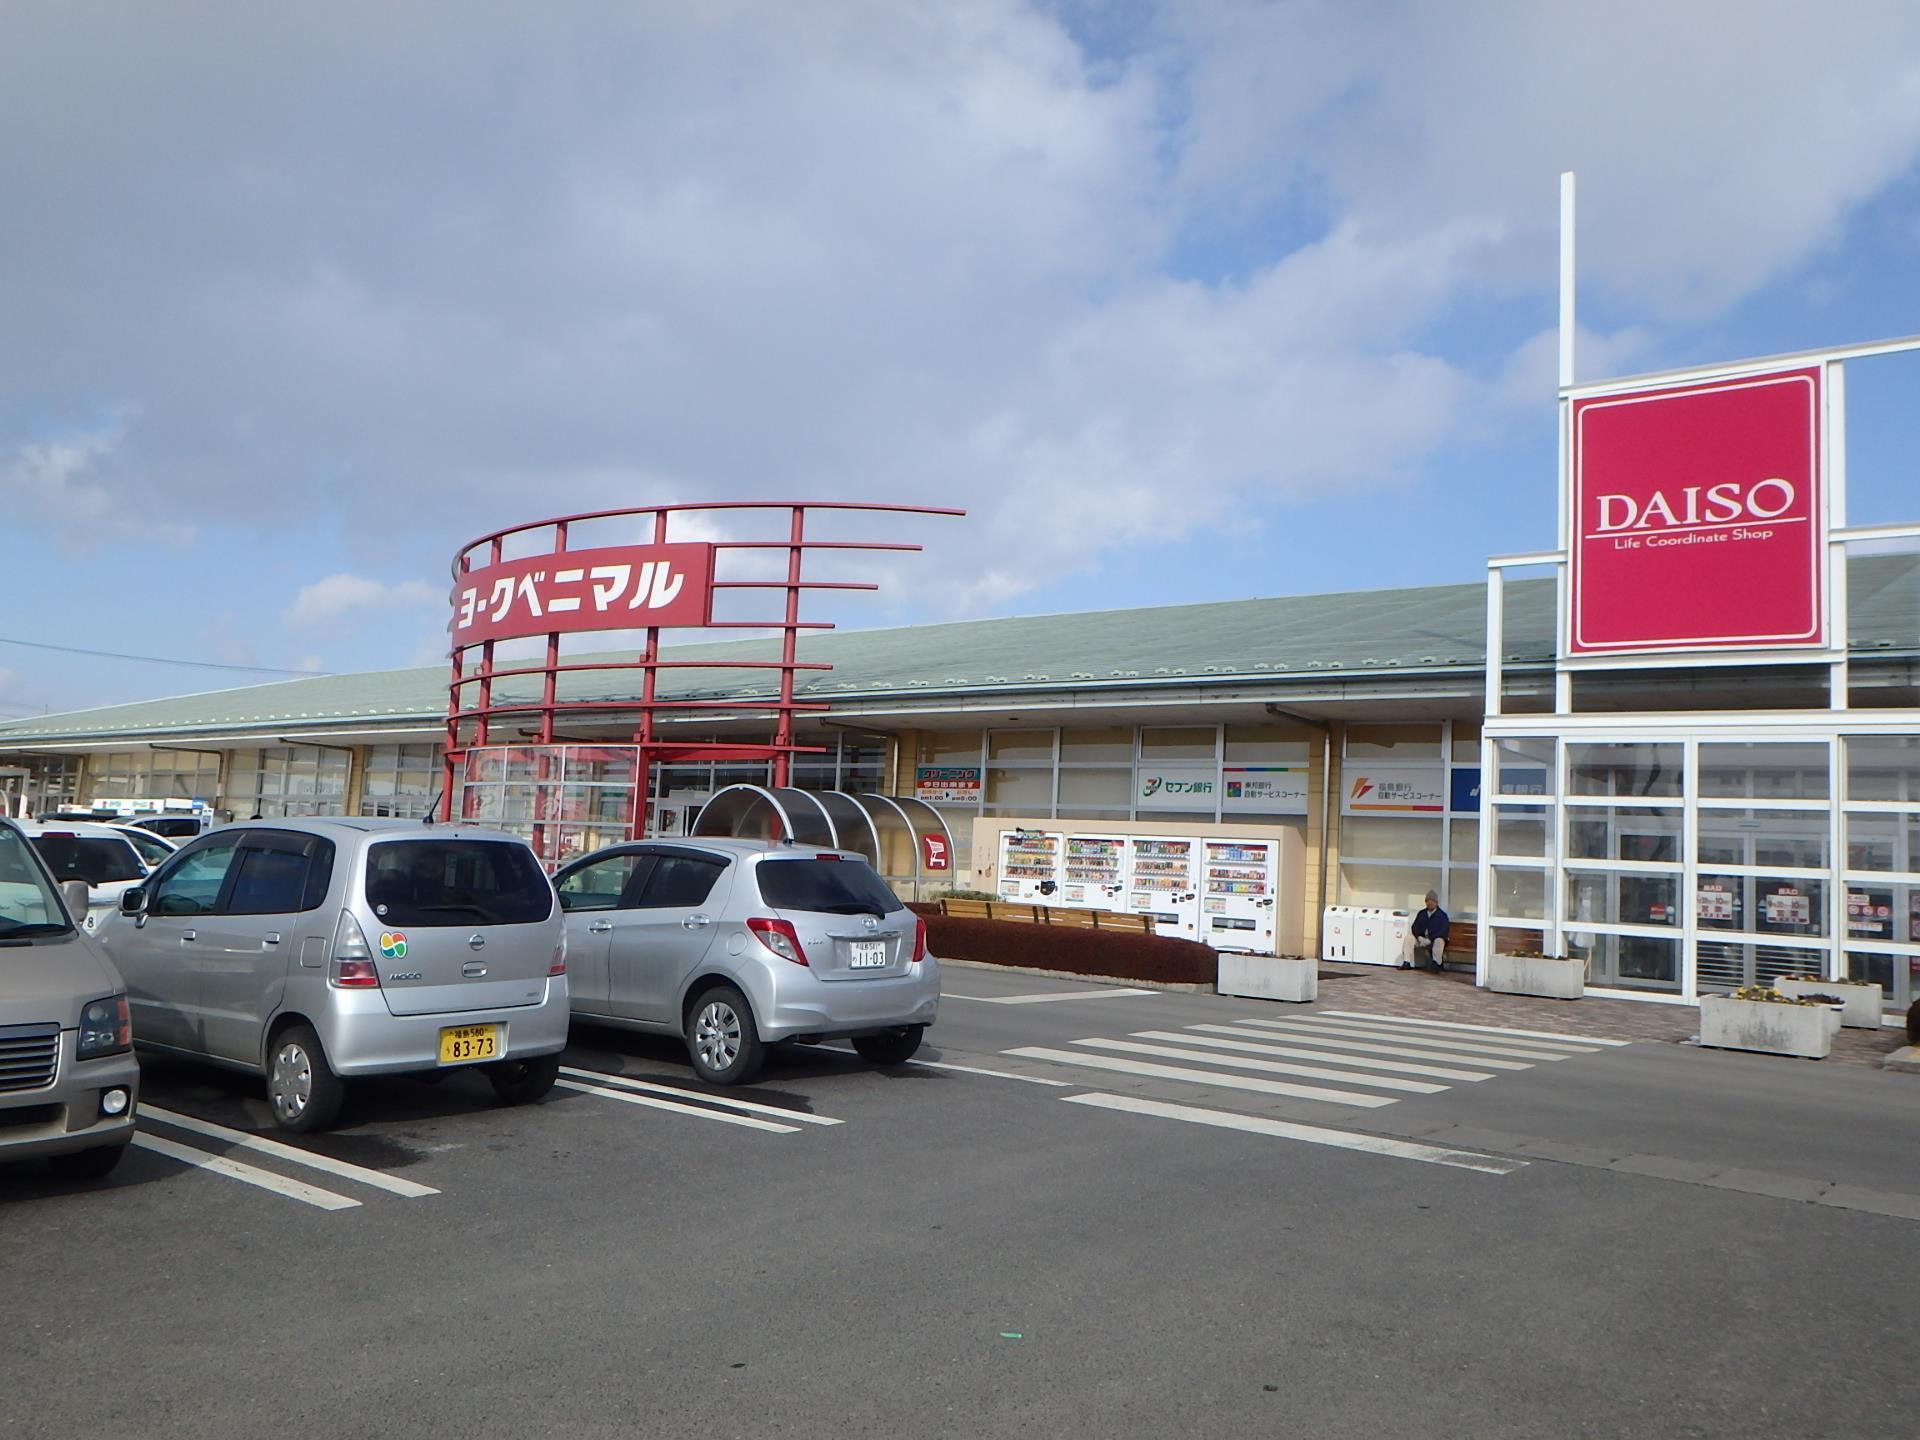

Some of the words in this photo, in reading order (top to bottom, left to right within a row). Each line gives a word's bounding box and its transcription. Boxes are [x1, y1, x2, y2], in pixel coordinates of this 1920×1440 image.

[1596, 478, 1795, 532] DAISO
[1614, 538, 1641, 550] Life
[1646, 532, 1728, 548] Coordinate
[1732, 528, 1774, 542] Shop
[458, 561, 684, 629] ヨークベニマル
[923, 769, 977, 780] クリーニング
[1165, 782, 1213, 793] セブン銀行
[1377, 791, 1442, 800] 自動サービスコーナー
[453, 1038, 493, 1058] 83-73
